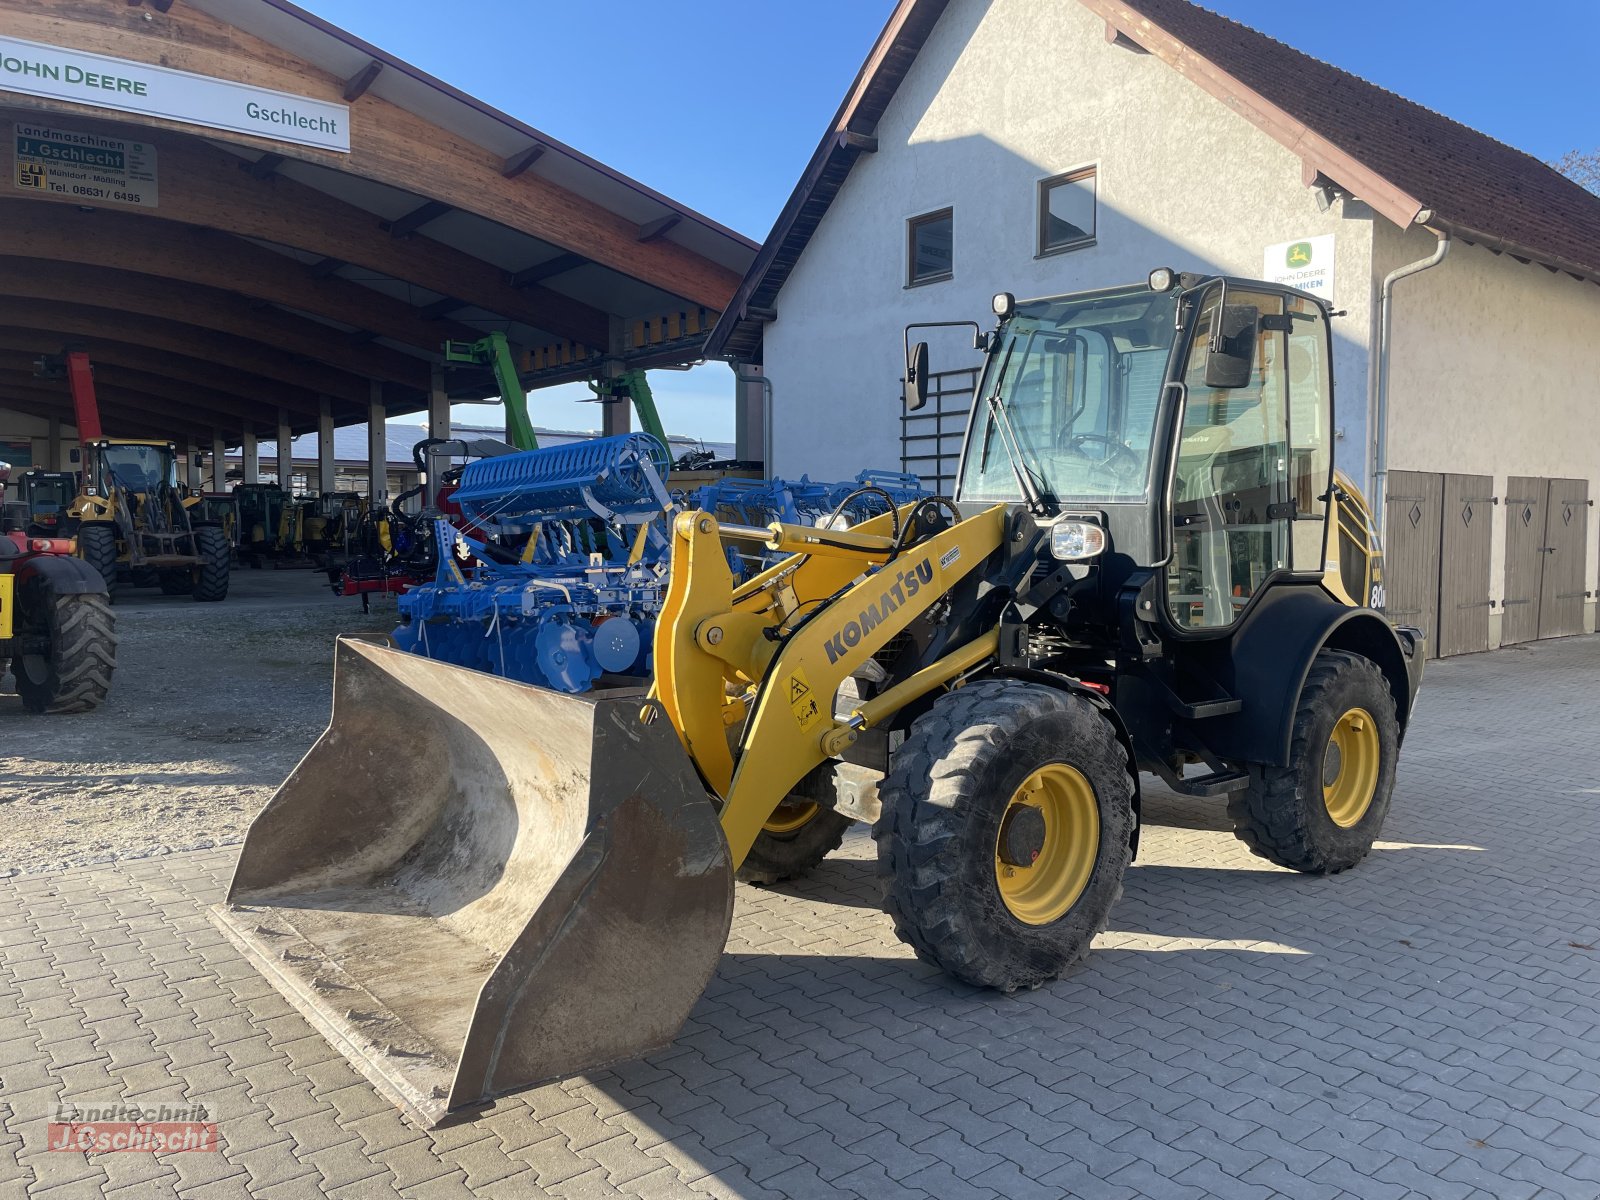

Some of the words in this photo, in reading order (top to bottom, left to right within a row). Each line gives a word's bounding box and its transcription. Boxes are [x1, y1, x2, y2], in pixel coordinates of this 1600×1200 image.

[65, 65, 148, 97] DEERE
[246, 102, 337, 135] Gschlecht
[17, 124, 125, 151] Landmaschinen
[22, 141, 35, 154] J.
[39, 144, 122, 167] Gschlecht
[49, 168, 87, 181] Mühldorf
[49, 182, 69, 193] Tel.
[73, 185, 104, 198] 08631
[114, 191, 141, 203] 6495
[1297, 269, 1326, 280] DEERE
[824, 557, 934, 665] KOMATSU
